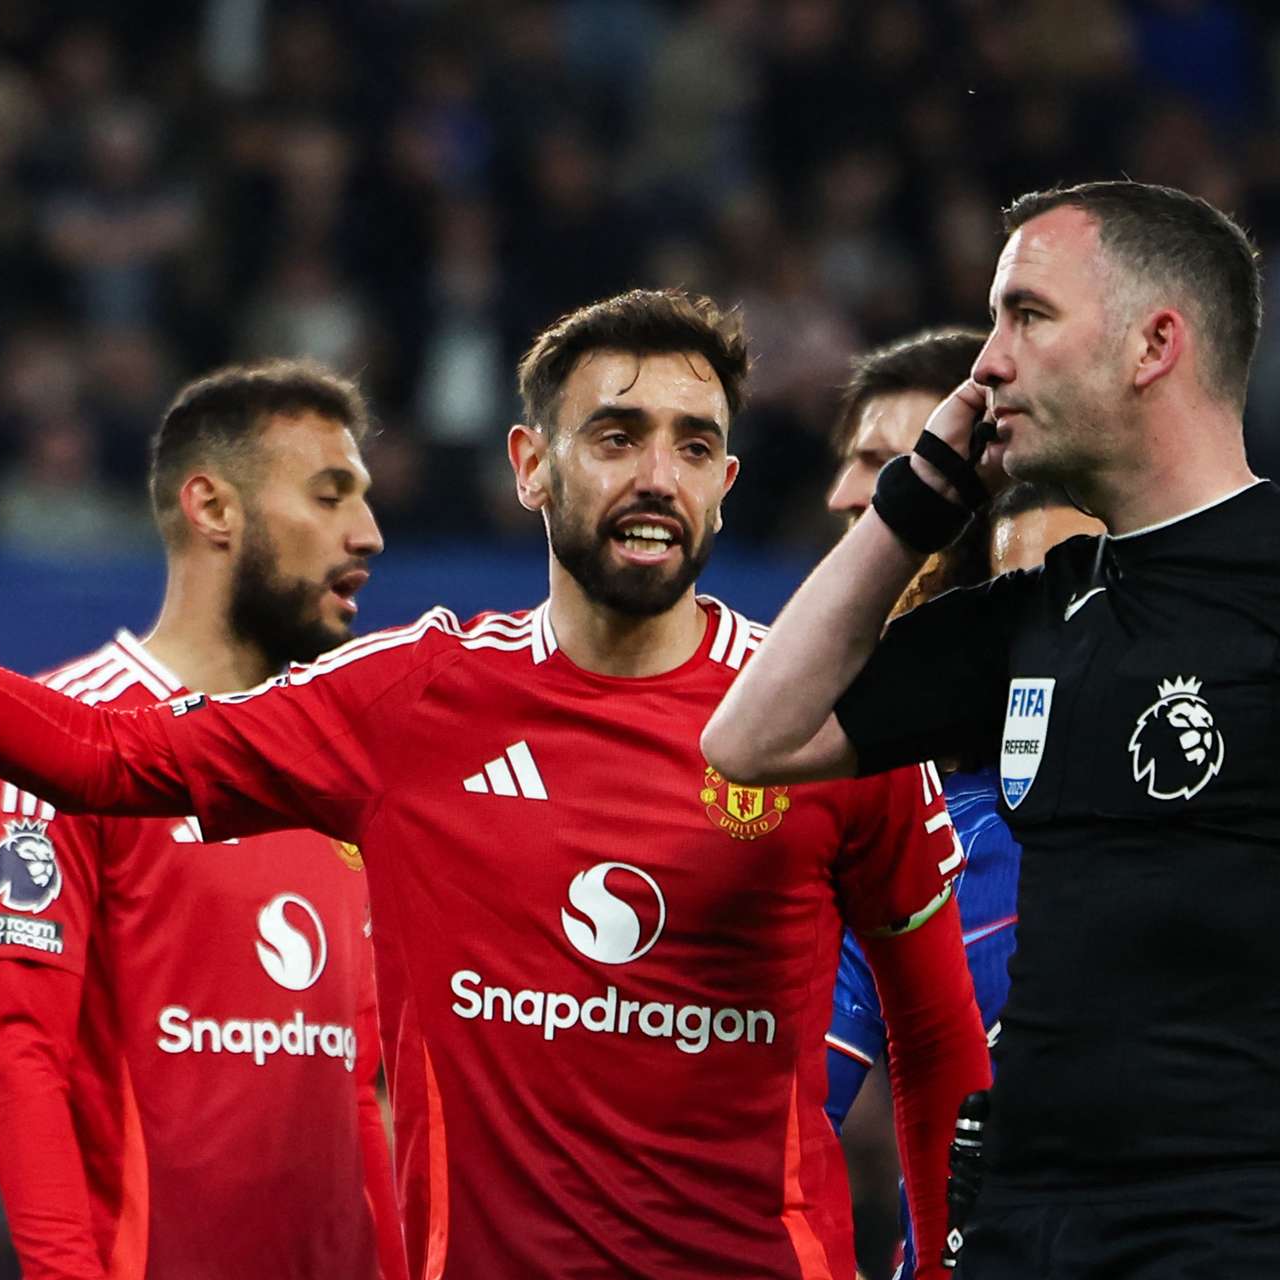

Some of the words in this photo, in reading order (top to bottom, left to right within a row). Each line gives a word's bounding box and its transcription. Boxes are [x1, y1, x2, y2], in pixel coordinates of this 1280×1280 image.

[1010, 688, 1045, 717] FIFA
[1004, 739, 1040, 755] REFEREE
[6, 917, 57, 940] room
[6, 930, 64, 955] racism
[450, 969, 776, 1054] Snapdragon
